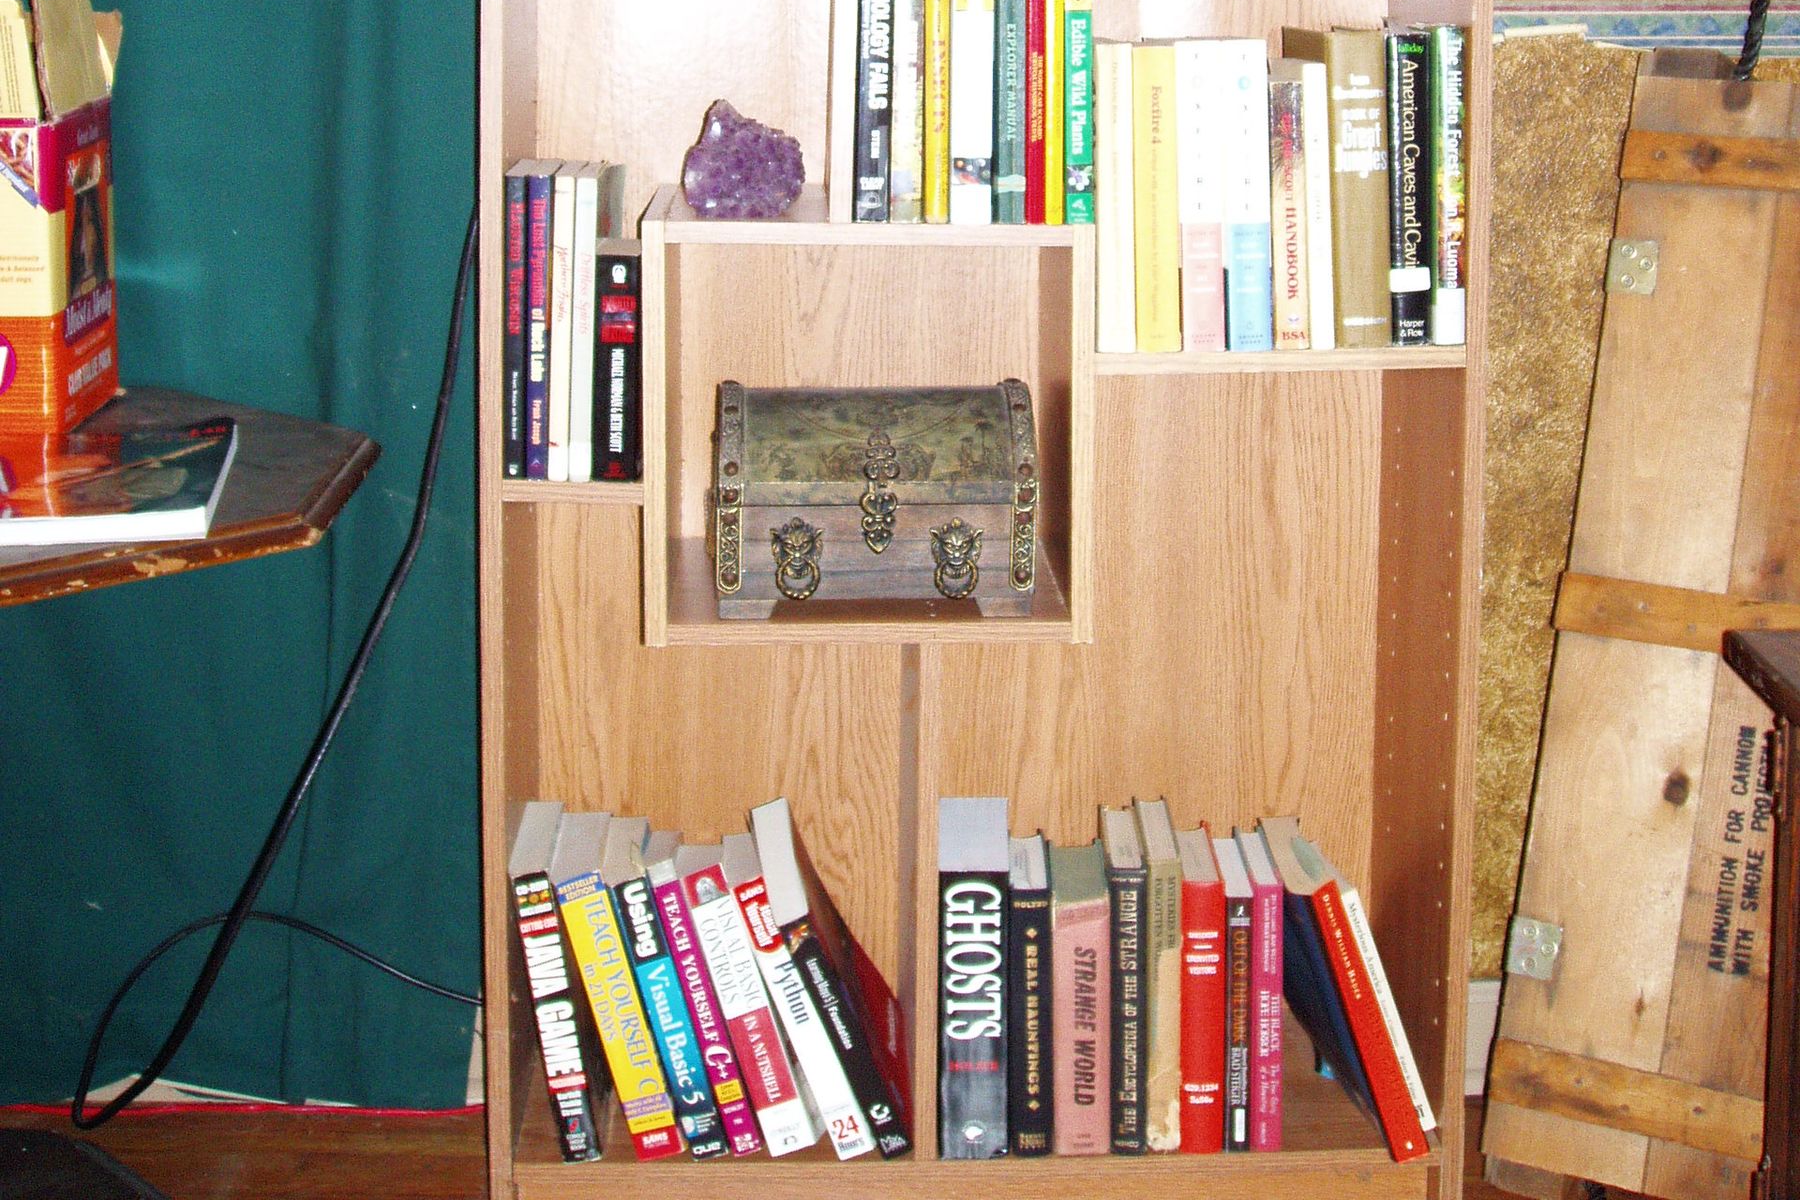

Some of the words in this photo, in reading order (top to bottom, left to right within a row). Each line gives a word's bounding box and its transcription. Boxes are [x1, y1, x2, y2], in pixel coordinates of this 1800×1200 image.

[1006, 23, 1017, 83] EXPLORER
[1070, 18, 1088, 67] Edible
[1446, 41, 1462, 65] The
[868, 62, 890, 110] FAILS
[932, 40, 946, 135] INSECTS
[1070, 68, 1087, 107] Wild
[1152, 86, 1163, 133] Foxfire
[1400, 59, 1419, 139] American
[1447, 69, 1462, 121] Hidden
[1006, 89, 1017, 141] MANUAL
[1070, 110, 1087, 155] Plants
[1152, 136, 1163, 145] 4
[1446, 128, 1461, 177] Forest
[1401, 142, 1421, 198] Caves
[532, 199, 546, 220] The
[1402, 198, 1421, 230] and
[1446, 193, 1461, 217] Jon
[508, 202, 524, 261] Haunted
[532, 222, 547, 247] Lost
[1285, 206, 1300, 300] HANDBOOK
[1446, 221, 1461, 238] R.
[530, 250, 546, 307] Pyramids
[1446, 240, 1461, 288] Luoma
[507, 266, 524, 335] Wisconsin
[531, 307, 544, 320] of
[578, 301, 592, 335] Spirits
[1400, 320, 1425, 329] Harper
[611, 348, 625, 377] MICHAEL
[609, 432, 623, 453] SCOTT
[610, 413, 623, 432] BETH
[1731, 725, 1757, 798] CANNON
[1723, 808, 1746, 844] FOR
[740, 884, 765, 903] SAMS
[1740, 847, 1766, 912] SMOKE
[622, 880, 659, 959] Using
[1120, 890, 1138, 970] STRANGE
[1321, 893, 1337, 929] DENNIS
[1334, 927, 1352, 969] WILLIAM
[1707, 856, 1739, 973] AMMUNITION
[522, 933, 570, 1000] JAVA
[700, 915, 741, 1006] CONTROLS
[718, 899, 744, 959] VISUAL
[734, 958, 762, 1010] BASIC
[944, 881, 1002, 1041] GHOSTS
[1232, 930, 1249, 958] OUT
[1349, 901, 1369, 953] Mysterious
[1365, 954, 1384, 995] America
[1731, 928, 1755, 977] WITH
[584, 963, 597, 982] in
[588, 982, 604, 1001] 21
[662, 891, 692, 952] TEACH
[682, 954, 718, 1043] YOURSELF
[704, 1044, 733, 1080] C++
[1074, 945, 1098, 1033] STRANGE
[1123, 975, 1138, 1000] THE
[1232, 959, 1247, 977] OF
[584, 898, 620, 966] TEACH
[609, 965, 653, 1070] YOURSELF
[638, 1078, 659, 1094] C
[646, 962, 685, 1034] Visual
[773, 959, 810, 1025] Python
[1124, 1003, 1138, 1018] OF
[1231, 979, 1248, 1006] THE
[1259, 990, 1270, 1017] HOPE
[1270, 994, 1280, 1017] THE
[535, 999, 584, 1078] GAME
[594, 1002, 618, 1045] DAYS
[1025, 995, 1041, 1096] HAUNTINGS
[1232, 1008, 1247, 1042] DARK
[1259, 1018, 1270, 1058] HORROR
[1270, 1018, 1281, 1053] BLACK
[665, 1030, 697, 1088] Basic
[753, 1044, 782, 1103] NUTSHELL
[1073, 1039, 1097, 1107] WORLD
[1119, 1020, 1138, 1103] ENCYCLOPEDIA
[1230, 1046, 1243, 1070] BRAD
[684, 1088, 705, 1105] 5
[1230, 1071, 1243, 1105] STEIGER
[642, 1131, 669, 1146] SAMS
[831, 1114, 860, 1141] 24
[1119, 1107, 1138, 1133] THE
